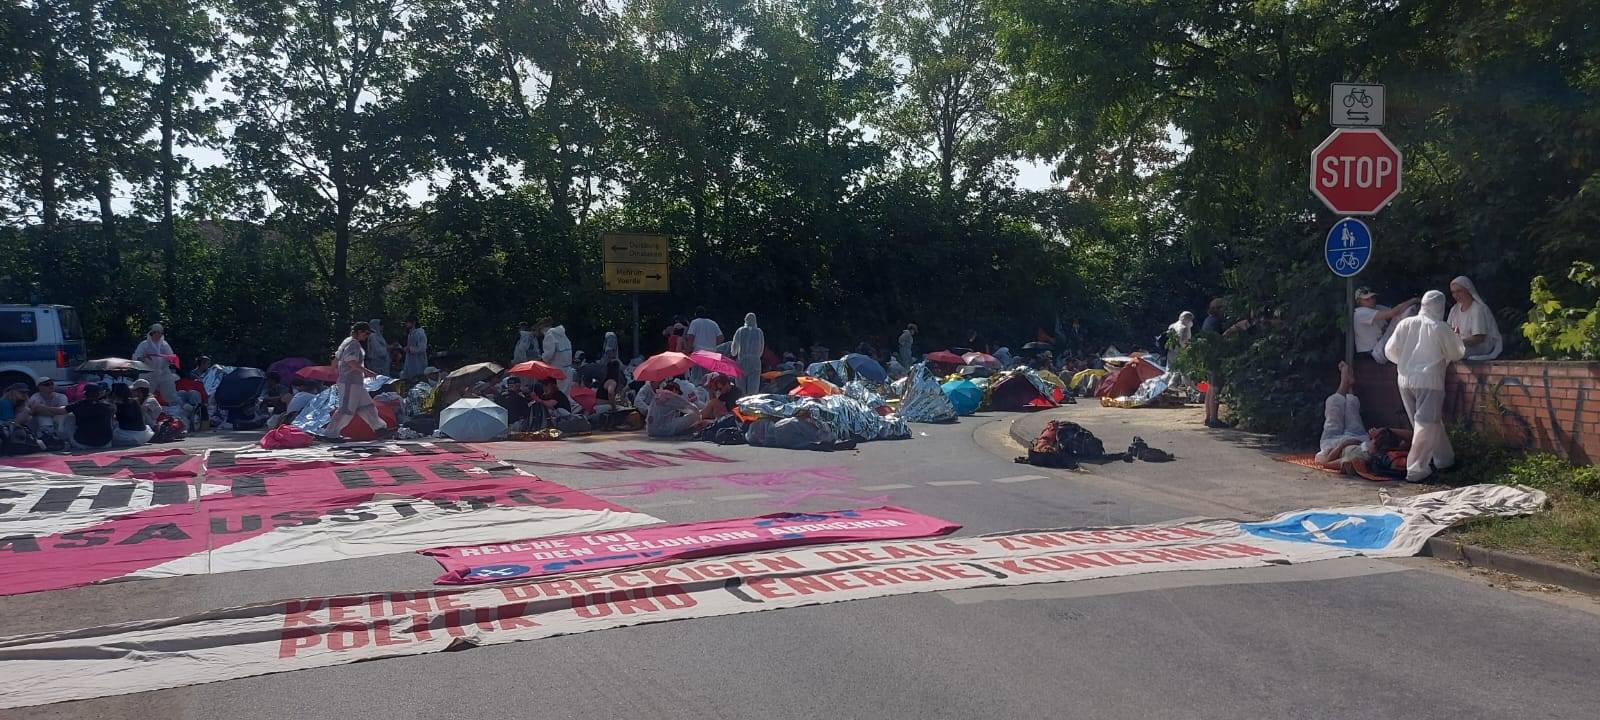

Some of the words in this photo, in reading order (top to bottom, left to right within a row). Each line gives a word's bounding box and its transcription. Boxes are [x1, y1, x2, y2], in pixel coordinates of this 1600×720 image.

[1322, 156, 1392, 188] STOP
[461, 539, 569, 557] REICHE
[532, 547, 594, 561] DEN
[607, 531, 759, 553] GELDHAHN
[767, 519, 908, 536] ABDREHEN
[284, 590, 470, 628] KEINE
[499, 556, 806, 601] DRECKIGEN
[815, 542, 978, 565] DEALS
[981, 526, 1216, 551] ZWISCHEN
[278, 601, 542, 659] POLITIK
[571, 583, 698, 619] UND
